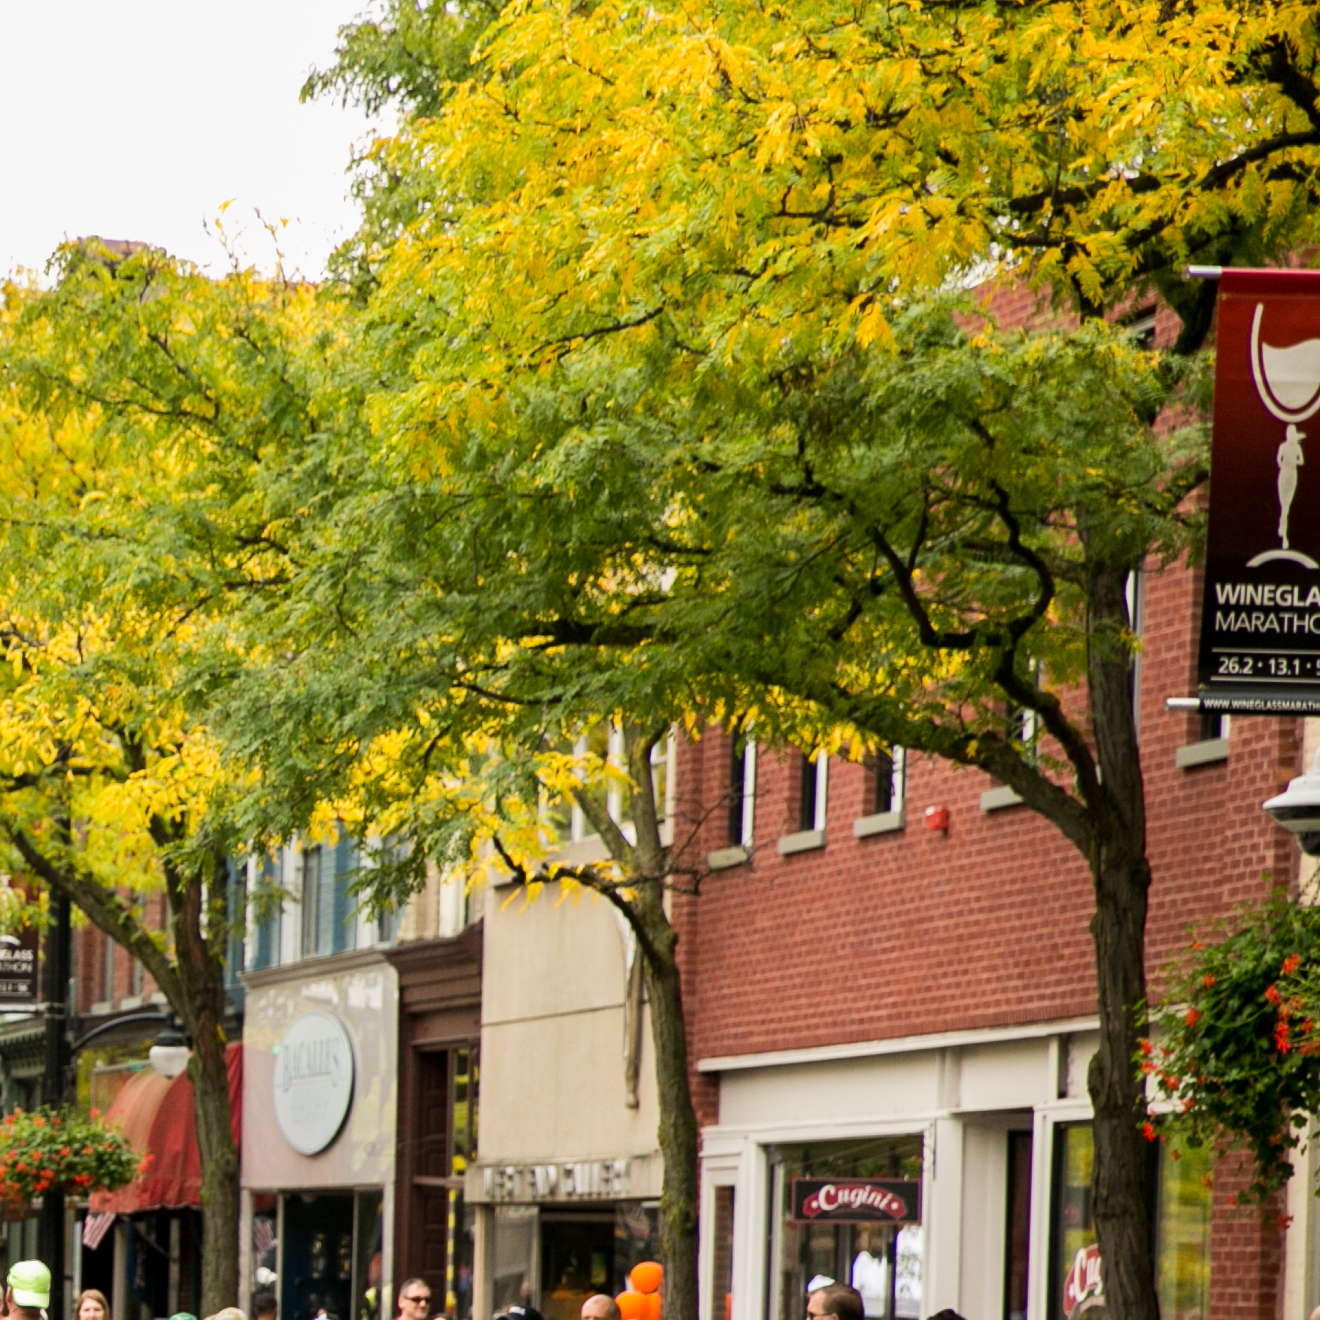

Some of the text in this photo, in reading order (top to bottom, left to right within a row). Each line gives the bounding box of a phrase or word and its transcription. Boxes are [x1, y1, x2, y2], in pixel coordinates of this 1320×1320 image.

[1218, 656, 1254, 674] 26.2
[1269, 658, 1300, 675] 13.1
[818, 1184, 893, 1211] Cugini
